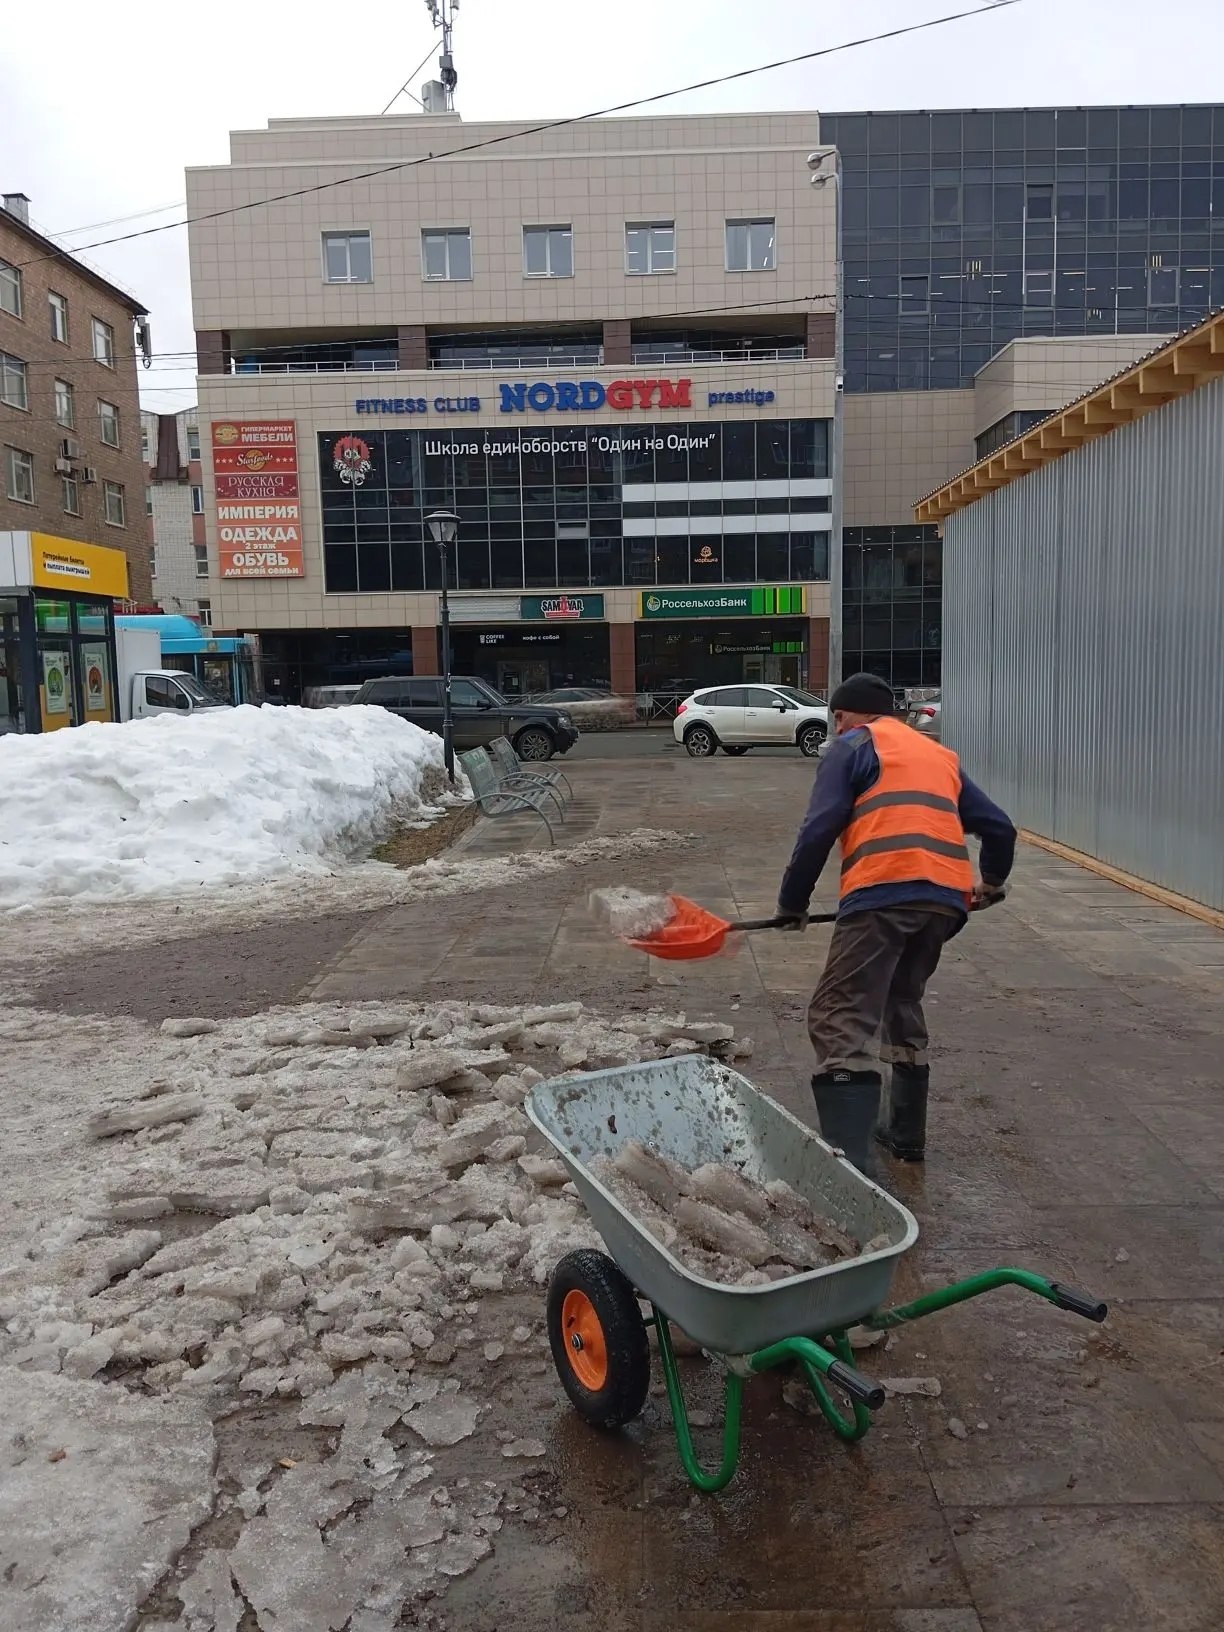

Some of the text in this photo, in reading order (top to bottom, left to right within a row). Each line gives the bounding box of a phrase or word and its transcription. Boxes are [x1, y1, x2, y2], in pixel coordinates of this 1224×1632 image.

[708, 388, 775, 408] prestige
[356, 396, 480, 414] FITNESS CLUB
[240, 425, 293, 433] ГИПЕРМАРКЕТ
[241, 432, 294, 443] МЕБЕЛИ
[425, 440, 479, 456] Школа
[482, 437, 587, 457] единоборств
[645, 438, 665, 450] на
[228, 476, 284, 487] РУССКАЯ
[237, 487, 276, 498] КУХНЯ
[218, 506, 298, 520] ИМПЕРИЯ
[220, 527, 298, 544] ОДЕЖДА
[232, 553, 289, 567] ОБУВЬ
[661, 596, 747, 609] РоссельхозБанк
[723, 643, 771, 653] РоссельхозБанк
